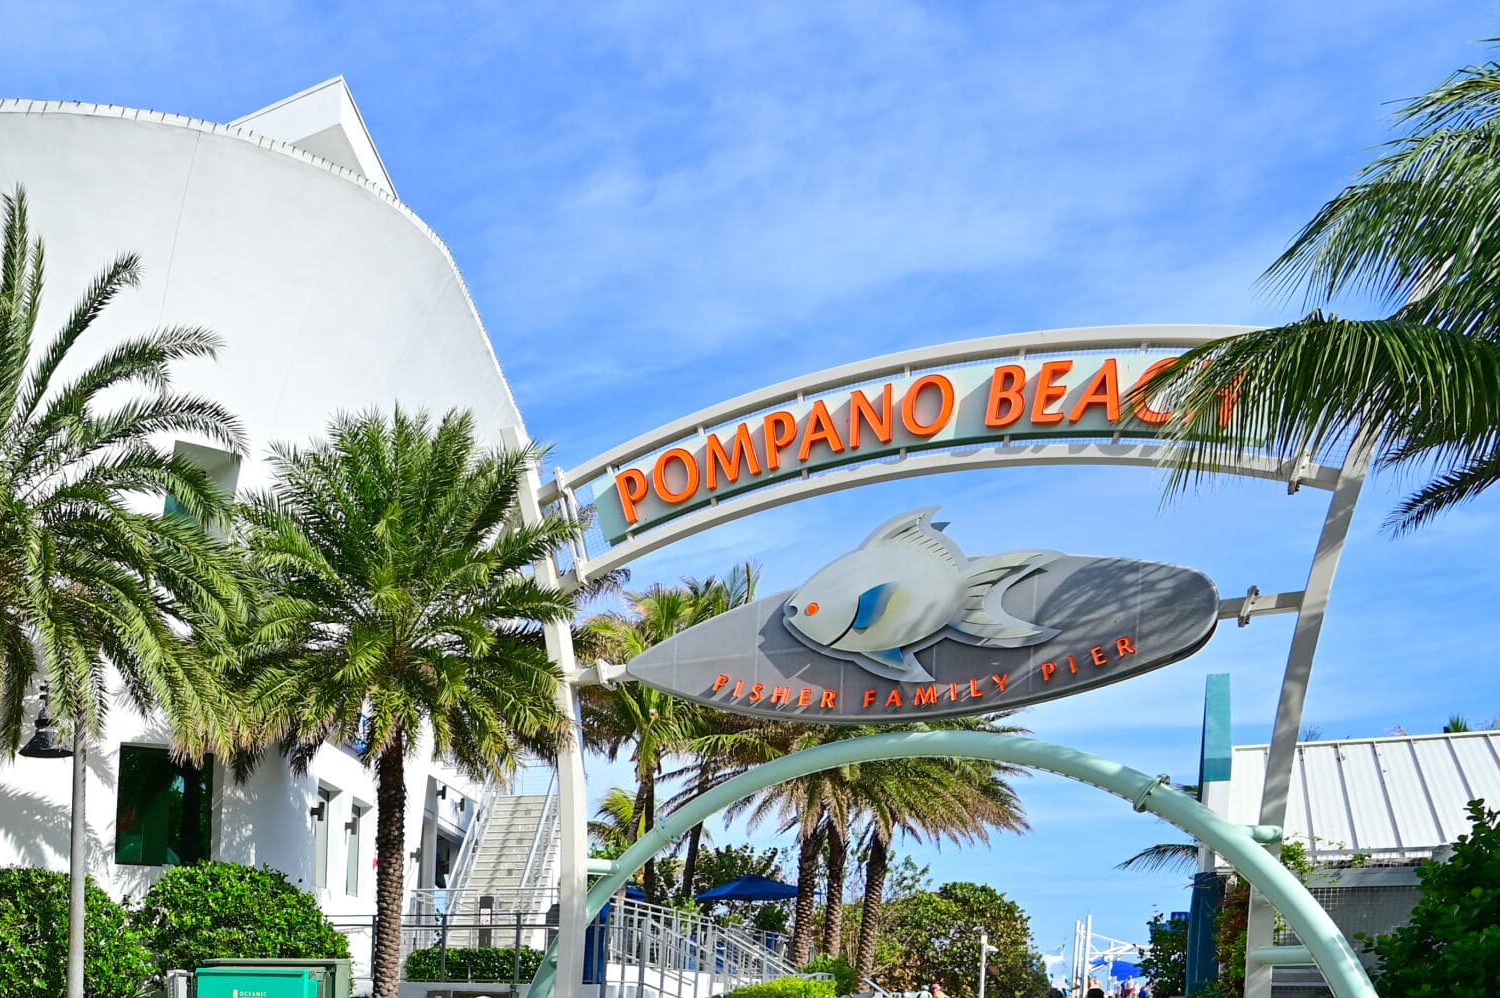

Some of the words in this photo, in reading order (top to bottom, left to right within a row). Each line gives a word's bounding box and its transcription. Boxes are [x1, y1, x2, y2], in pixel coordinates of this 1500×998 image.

[614, 374, 955, 524] POMPANO
[712, 674, 836, 708] FISHER
[863, 673, 1009, 708] FAMILY
[1041, 636, 1137, 681] PIER
